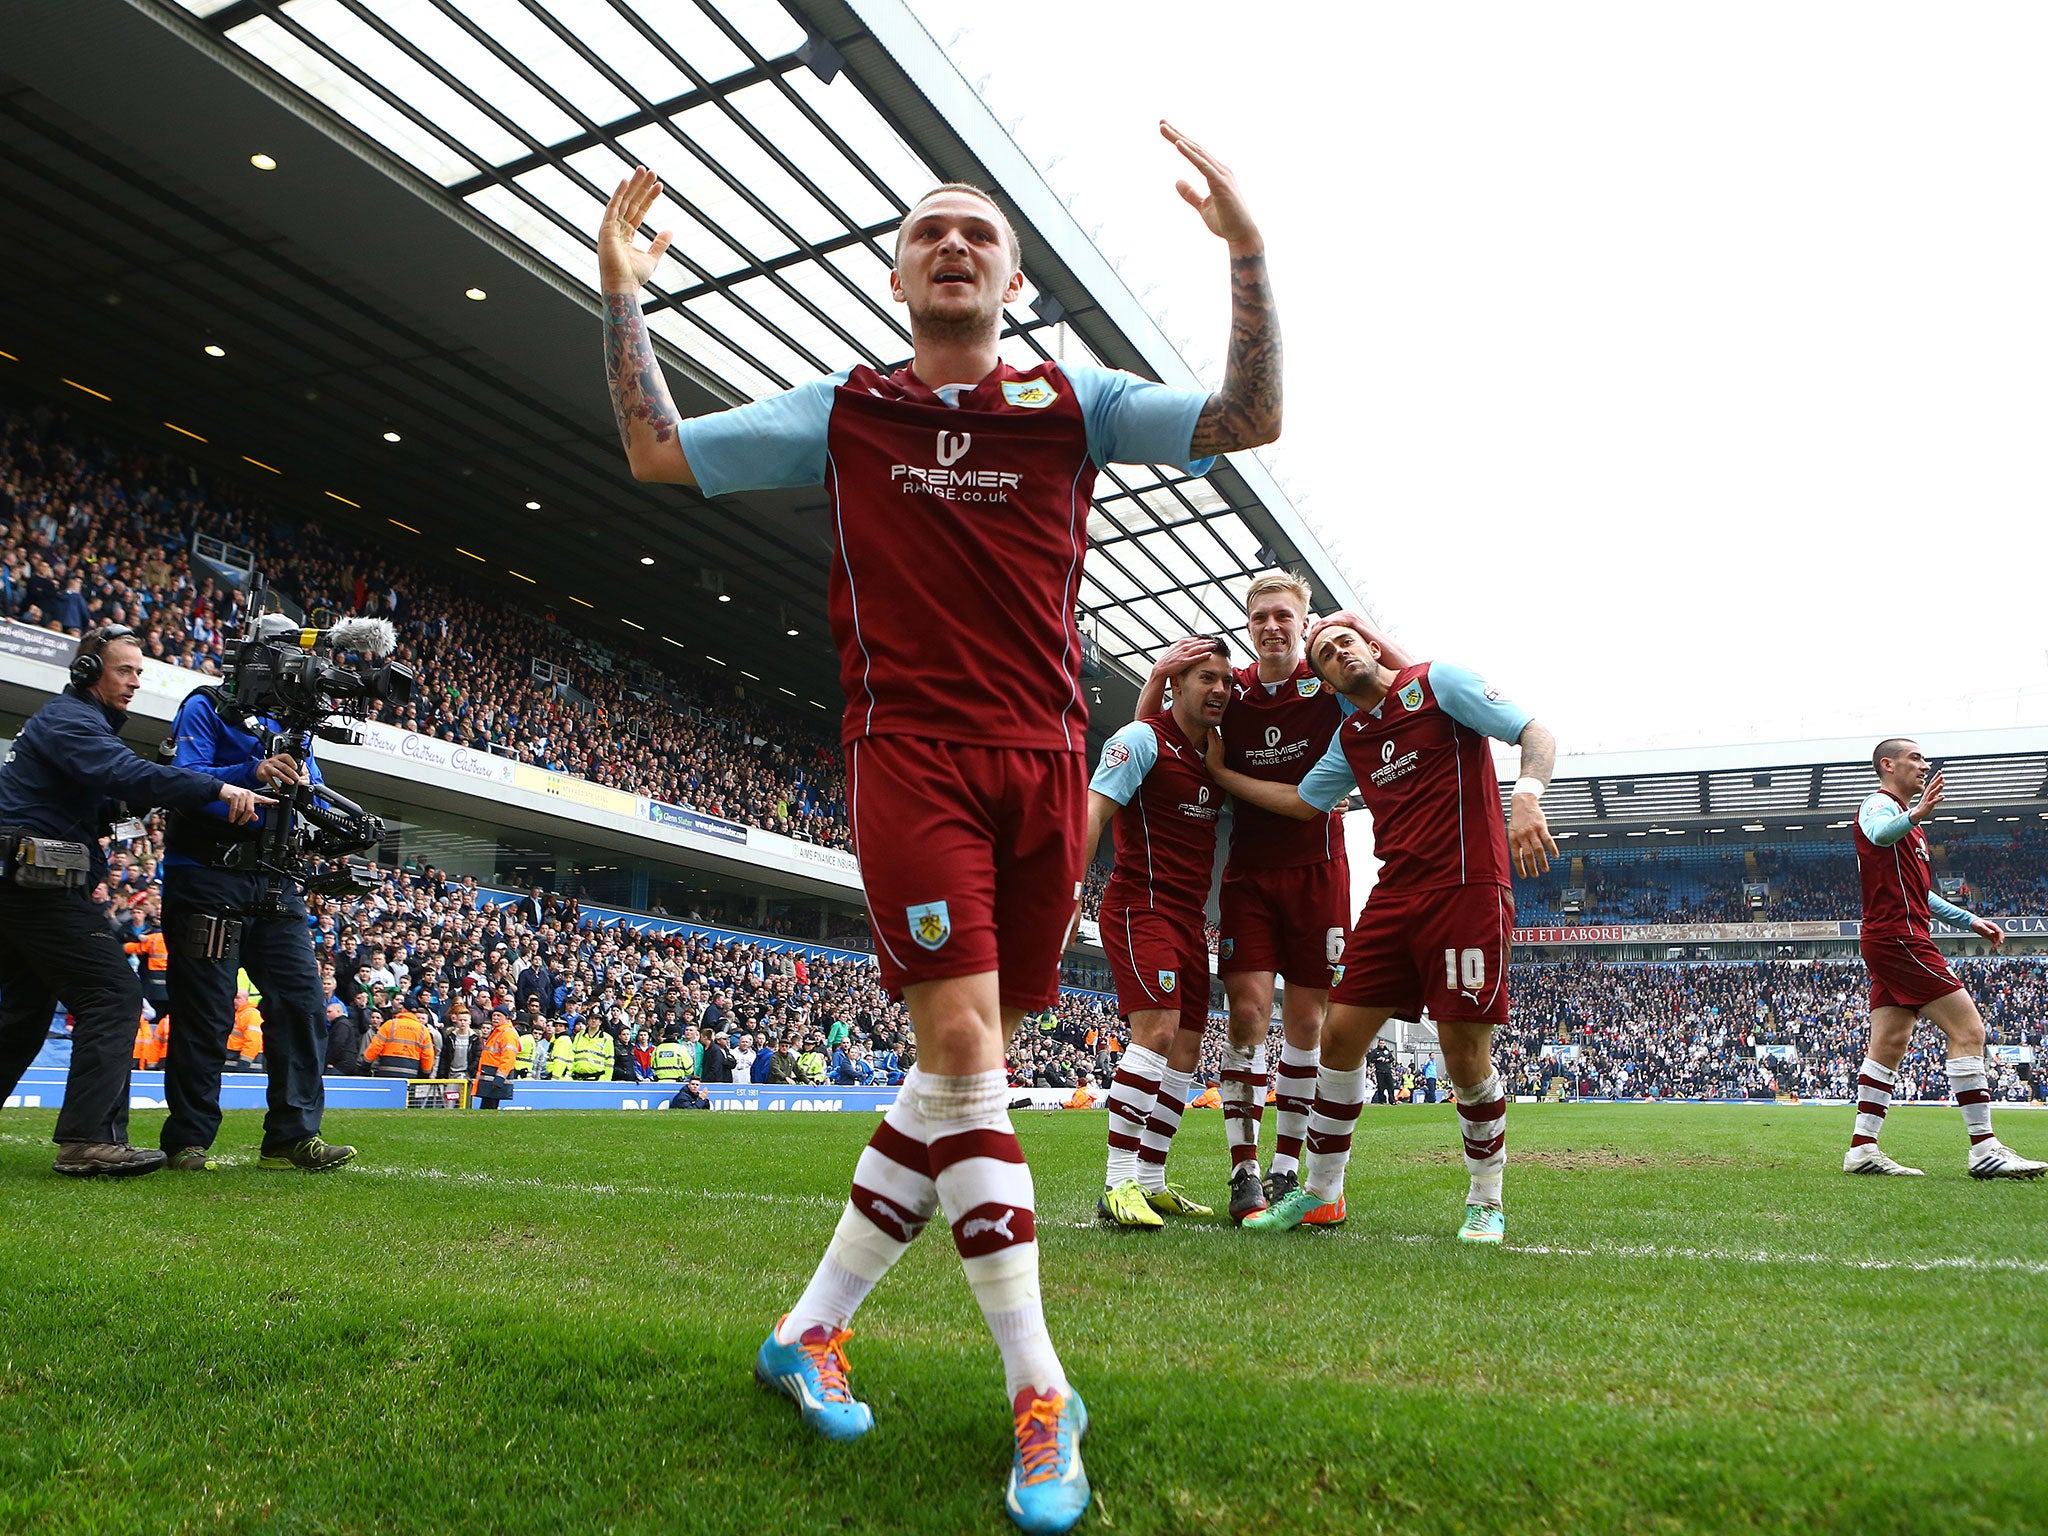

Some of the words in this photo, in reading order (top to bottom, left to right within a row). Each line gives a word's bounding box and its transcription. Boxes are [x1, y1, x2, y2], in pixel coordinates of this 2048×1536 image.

[891, 464, 1019, 490] PREMIER
[903, 482, 1008, 502] RANGE.co.uk
[402, 734, 446, 765] Cadbury
[451, 748, 493, 777] Cadbury
[1245, 739, 1308, 758] PREMIER
[1252, 751, 1304, 765] RANGE.co.uk
[1370, 751, 1419, 782] PREMIER
[1326, 927, 1346, 964] 6
[1539, 929, 1556, 941] ET
[1560, 927, 1620, 941] LABORE
[1444, 948, 1486, 990] 10
